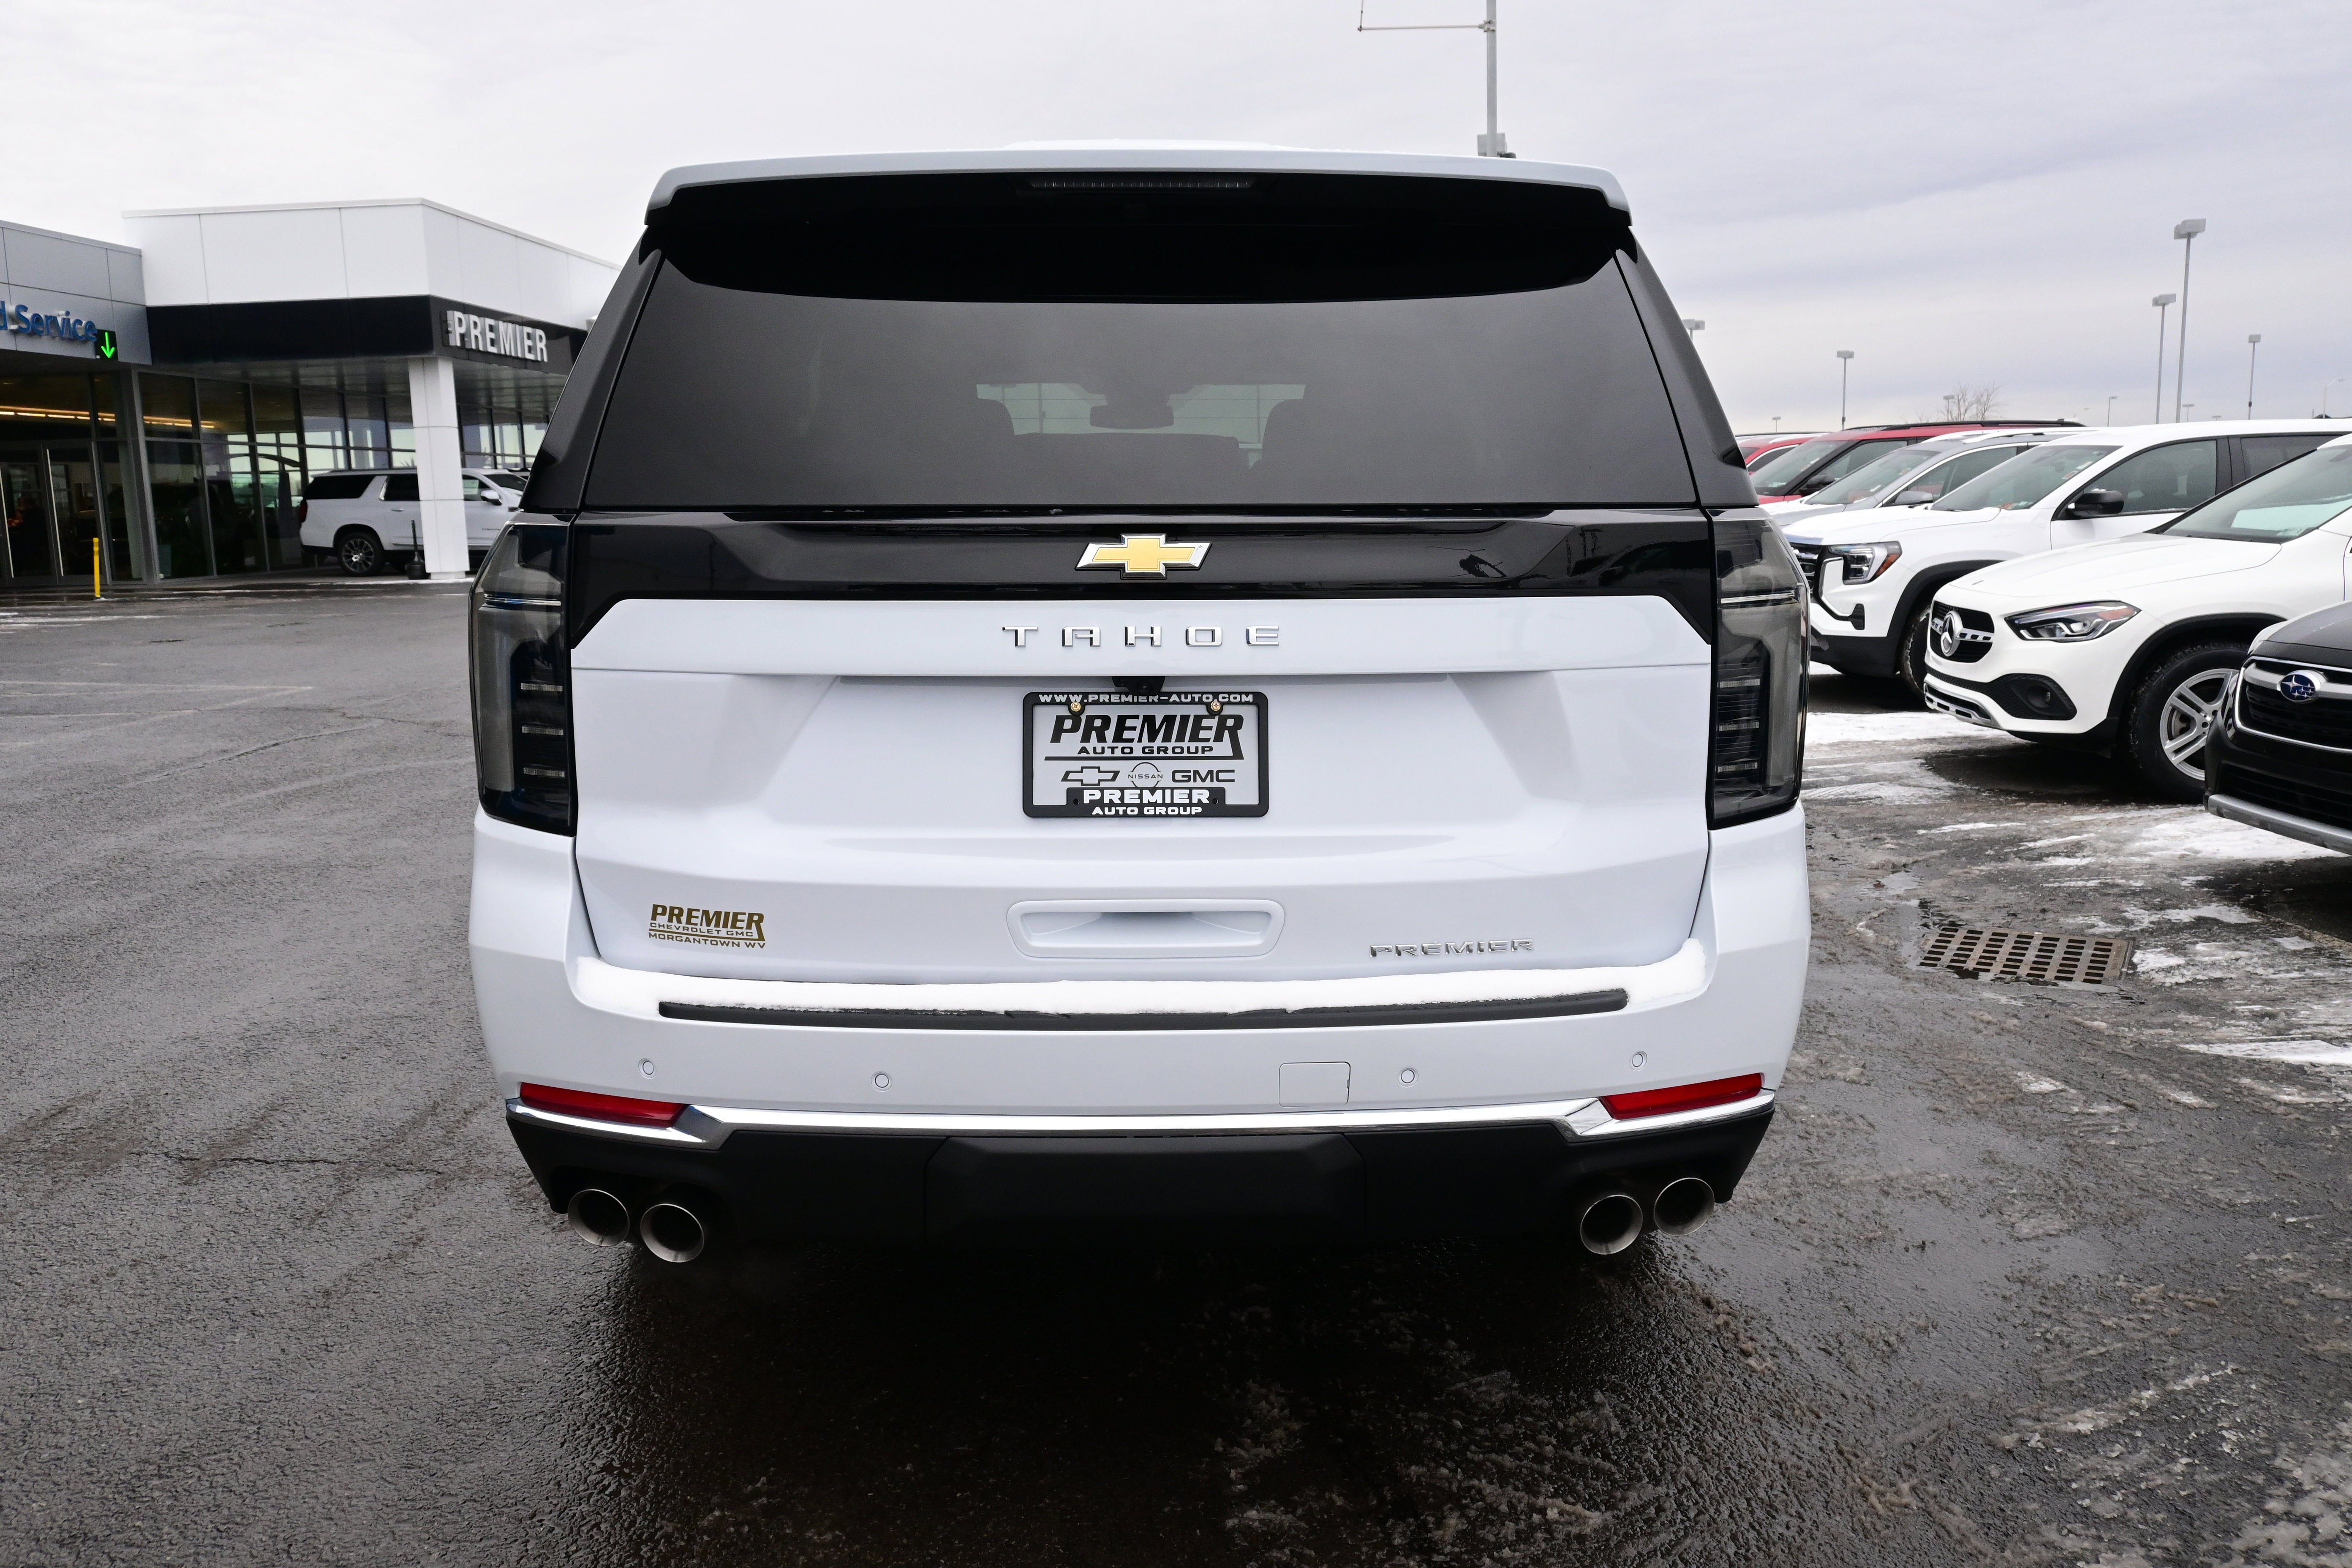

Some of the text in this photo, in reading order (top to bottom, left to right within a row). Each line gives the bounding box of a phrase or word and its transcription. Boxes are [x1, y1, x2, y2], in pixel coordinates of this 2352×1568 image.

[15, 304, 97, 342] Service
[448, 310, 548, 362] PREMIER
[1002, 625, 1279, 647] TAHOE
[1038, 694, 1254, 702] WWW.PREMIER-AUTO.COM
[1050, 714, 1244, 750] PREMIER
[1077, 746, 1214, 755] AUTO GROUP
[1171, 769, 1236, 783] GMC
[1083, 789, 1210, 804] PREMIER
[1092, 806, 1203, 815] AUTO GROUP
[651, 904, 765, 934] PREMIER
[650, 922, 721, 935] CHEVROLET
[648, 932, 740, 947] MORGANTOWN
[1369, 938, 1534, 958] PREMIER
